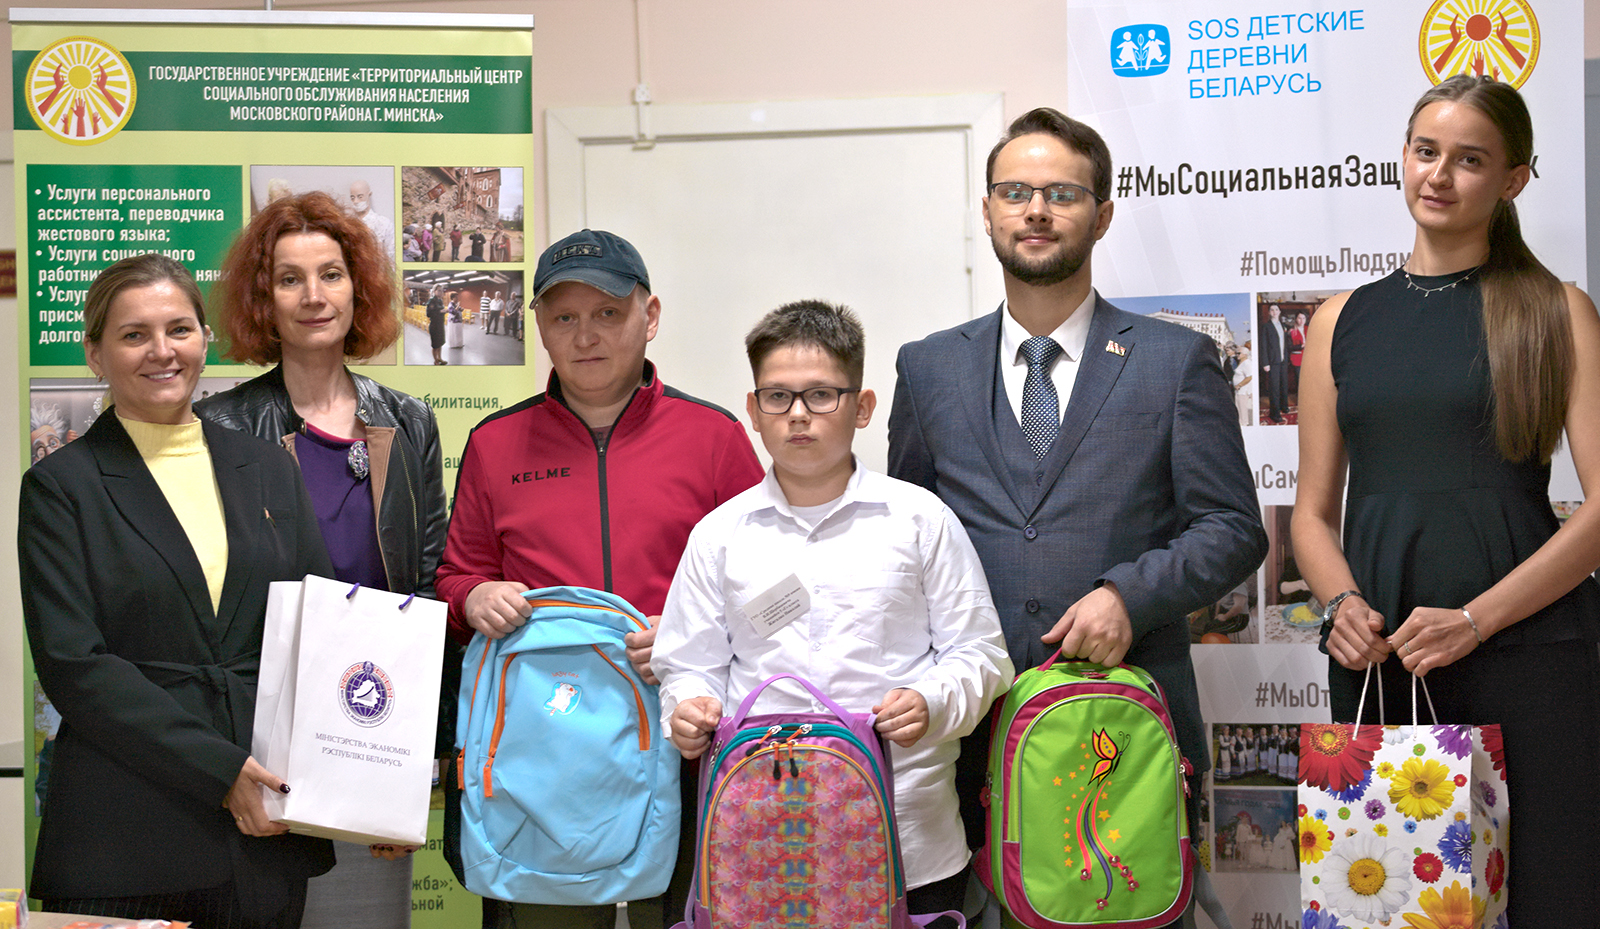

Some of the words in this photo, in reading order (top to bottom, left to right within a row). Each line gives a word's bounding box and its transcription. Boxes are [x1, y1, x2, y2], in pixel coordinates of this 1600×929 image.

[1188, 18, 1240, 40] SOS
[1247, 10, 1365, 41] ДЕТСКИЕ
[1188, 43, 1307, 74] ДЕРЕВНИ
[149, 66, 266, 82] ГОСУДАРСТВЕННОЕ
[268, 68, 350, 82] УЧРЕЖДЕНИЕ
[352, 66, 482, 84] «ТЕРРИТОРИАЛЬНЫЙ
[484, 70, 523, 86] ЦЕНТР
[203, 86, 294, 102] СОЦИАЛЬНОГО
[296, 87, 397, 102] ОБСЛУЖИВАНИЯ
[399, 89, 470, 103] НАСЕЛЕНИЯ
[1189, 73, 1322, 99] БЕЛАРУСЬ
[230, 106, 322, 122] МОСКОВСКОГО
[324, 104, 372, 122] РАЙОНА
[374, 108, 383, 122] Г.
[384, 108, 444, 123] МИНСКА»
[48, 184, 96, 204] Услуги
[101, 188, 212, 204] персонального
[38, 208, 124, 222] ассистента,
[129, 208, 224, 224] переводчика
[38, 229, 115, 242] жестового
[120, 229, 171, 244] языка;
[48, 245, 98, 266] Услуги
[38, 266, 102, 286] работни
[48, 285, 89, 306] Услуг
[39, 310, 84, 326] присм
[38, 330, 86, 345] долго
[512, 467, 570, 485] KELME
[366, 754, 402, 768] БЕЛАРУСЬ
